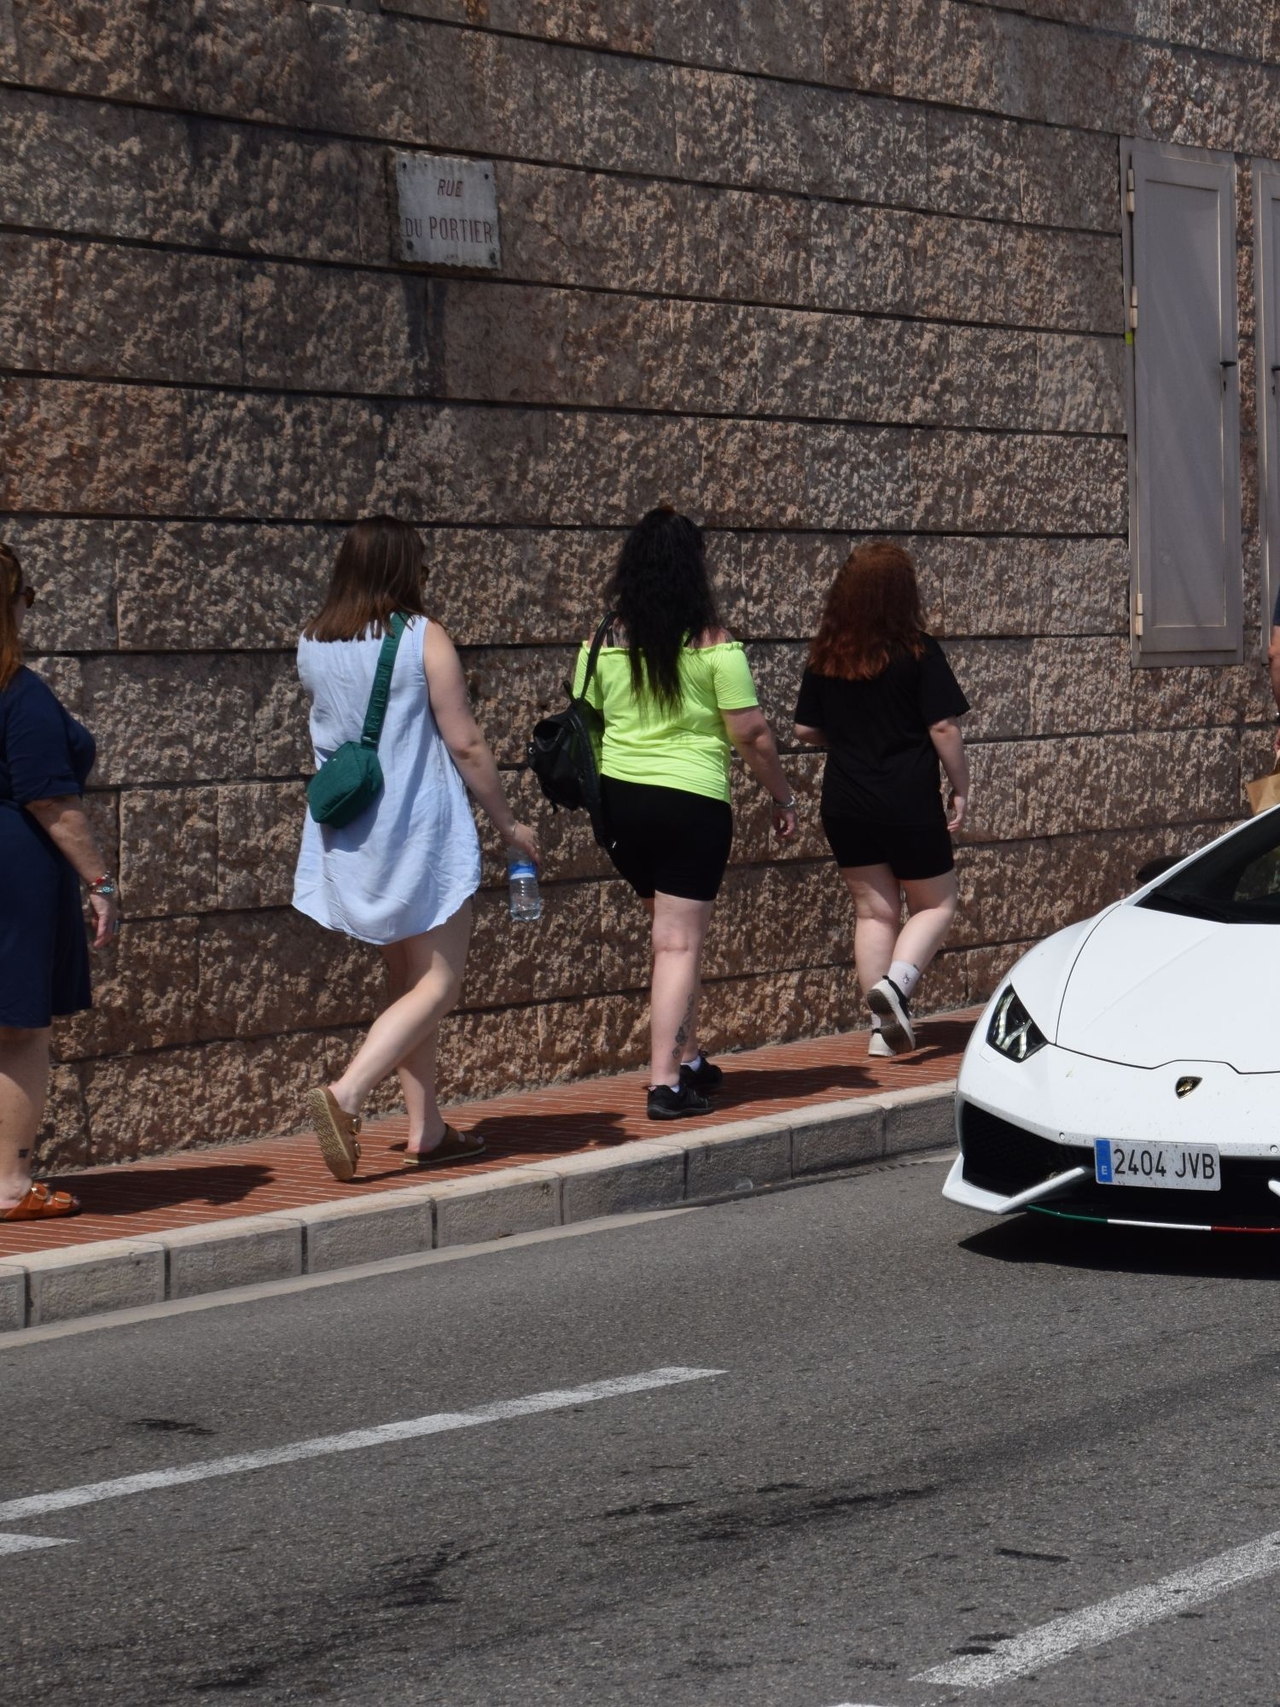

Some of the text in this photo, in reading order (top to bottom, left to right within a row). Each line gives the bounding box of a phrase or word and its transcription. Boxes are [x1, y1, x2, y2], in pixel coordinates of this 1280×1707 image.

[437, 179, 464, 197] RUE
[405, 216, 493, 244] DU PORTIER
[1101, 1165, 1108, 1175] E
[1113, 1148, 1215, 1180] 2404 JVB
